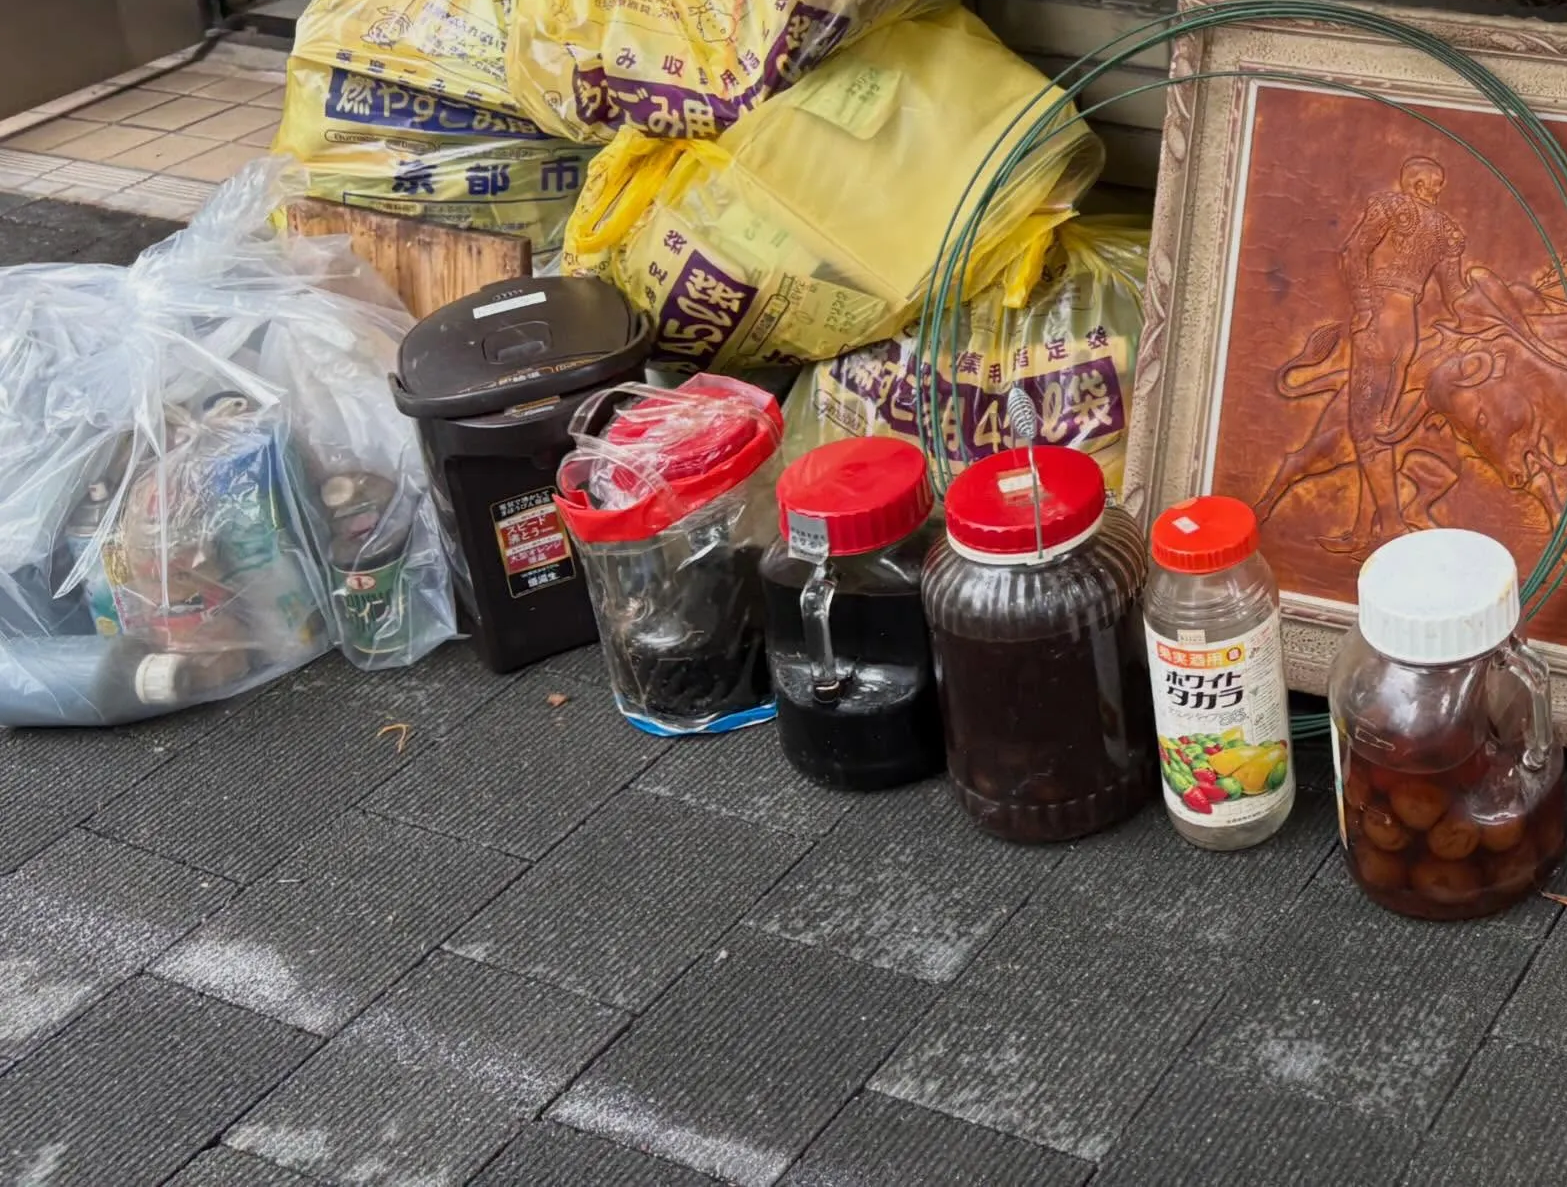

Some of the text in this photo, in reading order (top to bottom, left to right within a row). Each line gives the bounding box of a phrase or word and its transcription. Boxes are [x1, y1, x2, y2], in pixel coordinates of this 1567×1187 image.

[1166, 671, 1241, 689] ホワイト
[1167, 686, 1244, 710] タカラ
